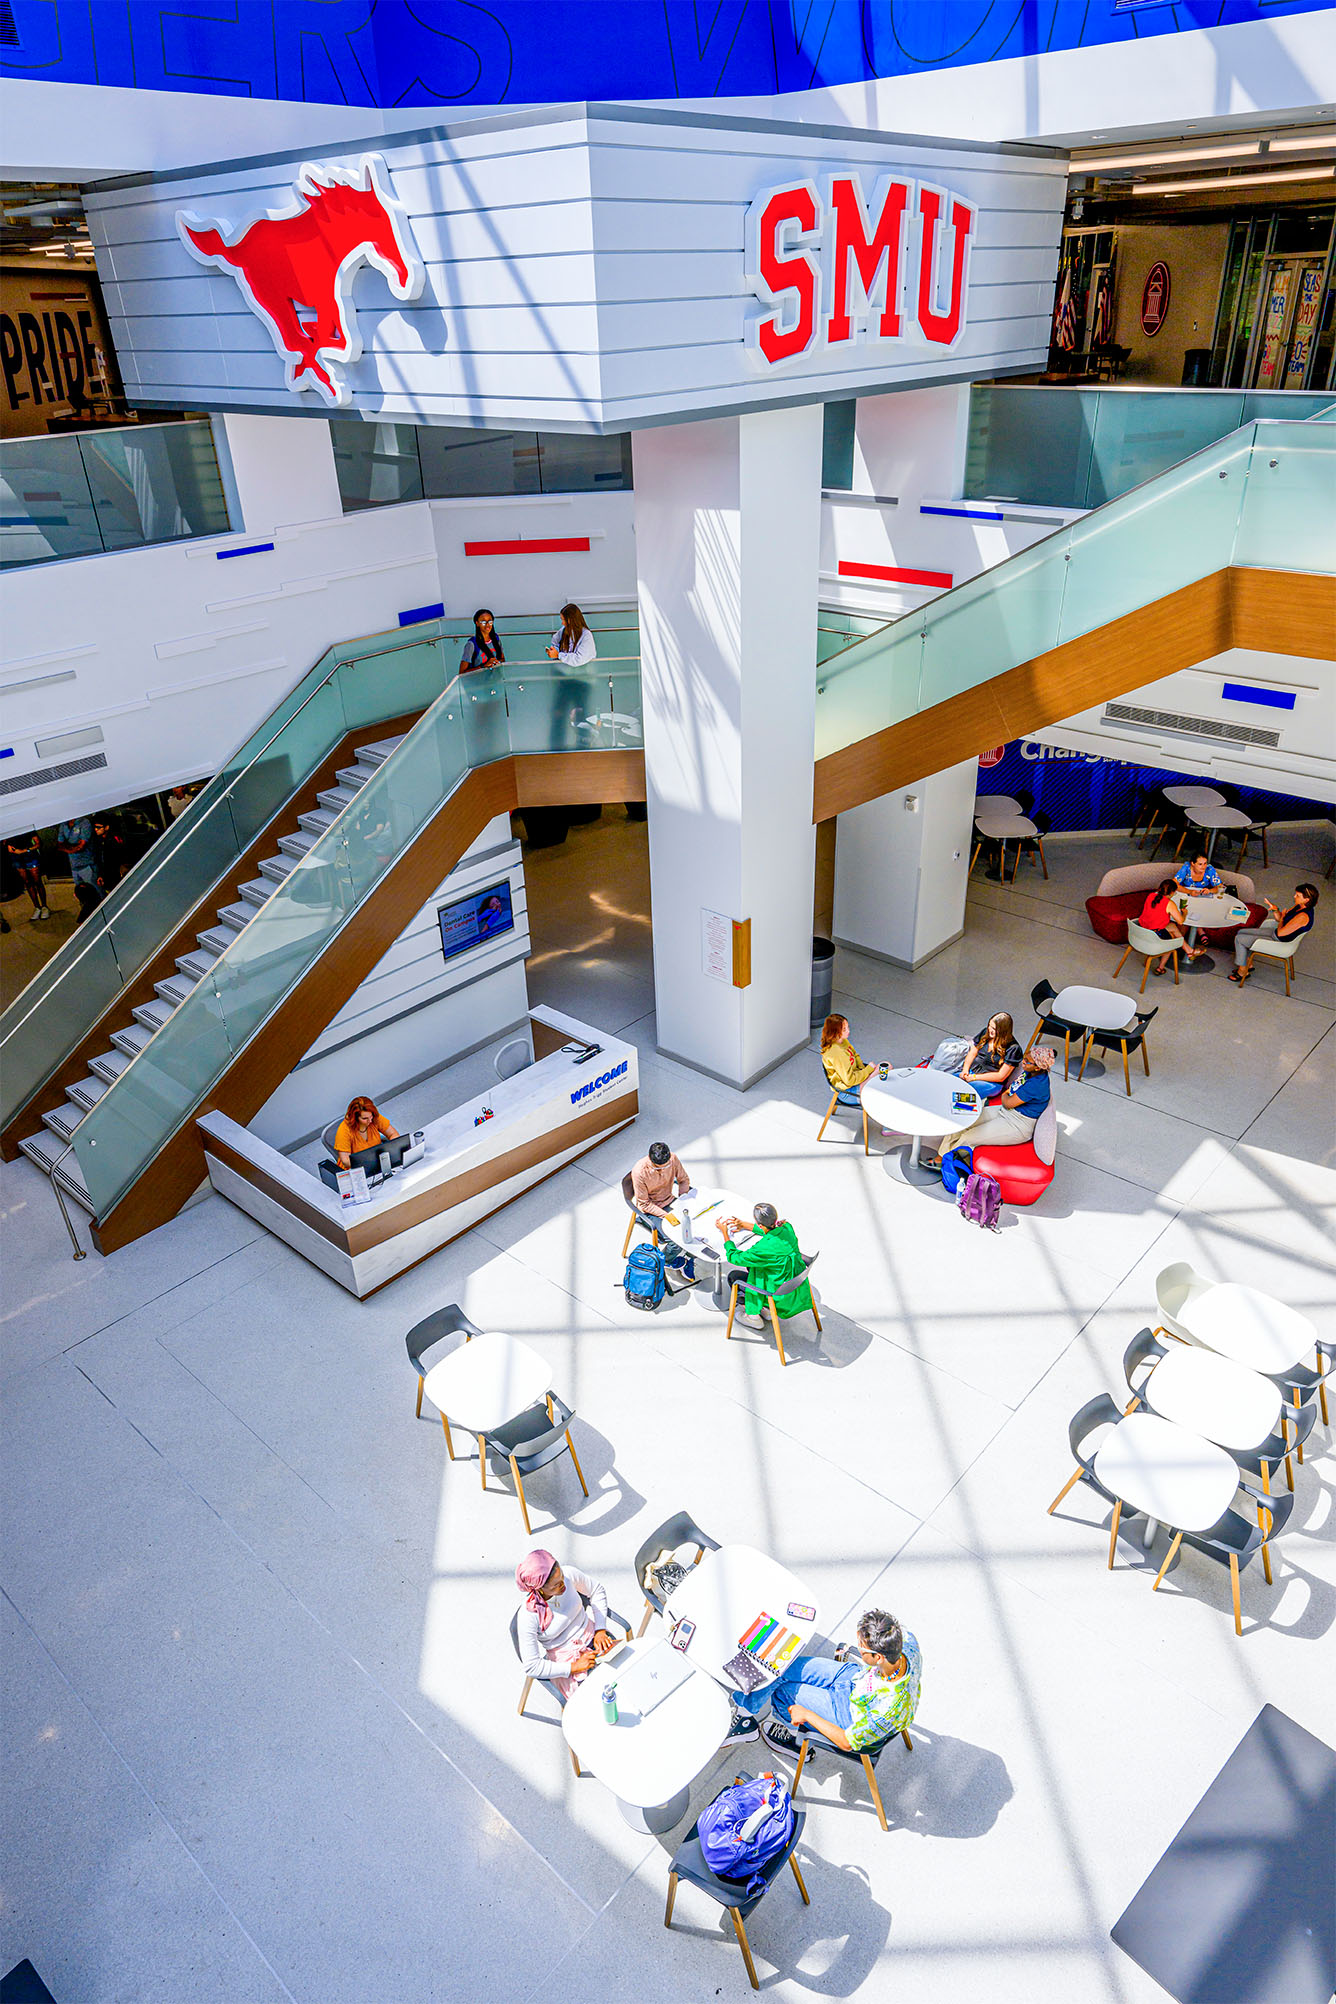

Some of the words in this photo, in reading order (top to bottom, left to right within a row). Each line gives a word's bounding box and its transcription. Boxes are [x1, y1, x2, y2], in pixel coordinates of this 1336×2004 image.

[758, 178, 973, 364] SMU
[1304, 273, 1321, 292] SEAS
[1298, 303, 1317, 325] DAY
[0, 311, 104, 410] PRIDE
[570, 1060, 628, 1104] WELCOME
